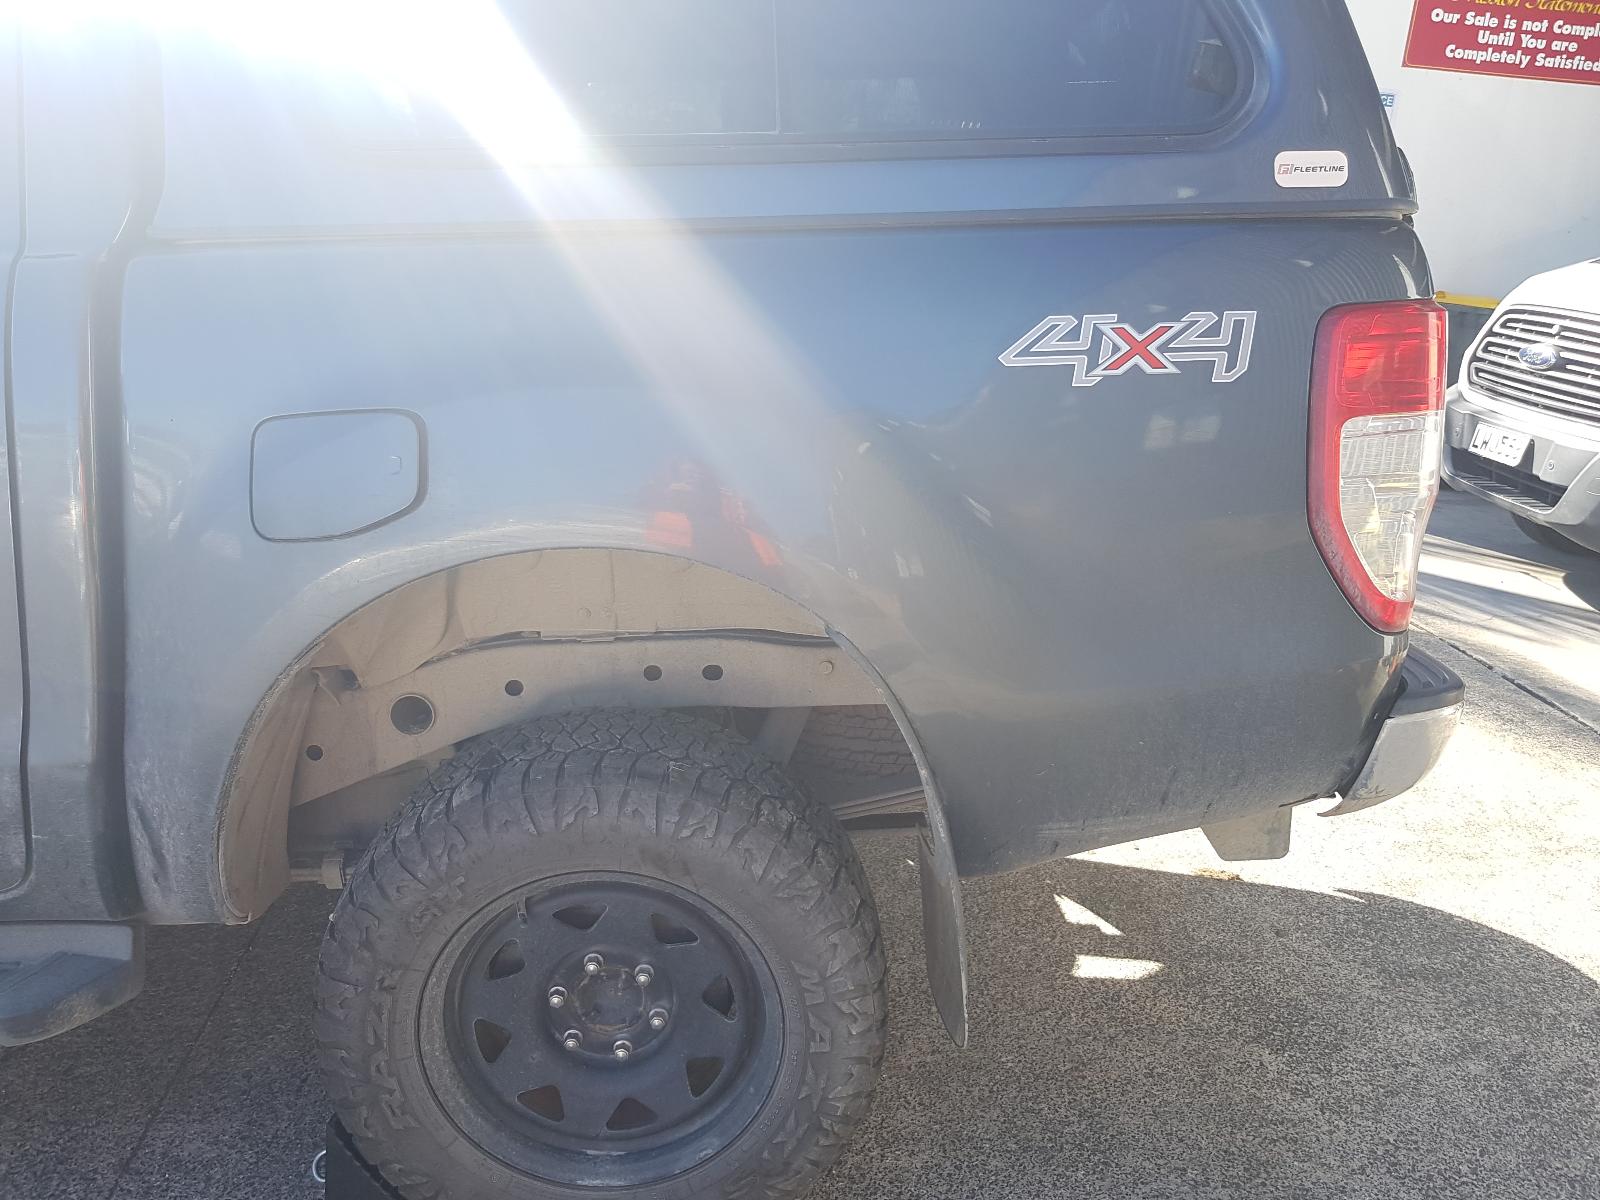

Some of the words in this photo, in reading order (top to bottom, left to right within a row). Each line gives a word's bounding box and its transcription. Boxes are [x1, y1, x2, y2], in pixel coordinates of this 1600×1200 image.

[1431, 8, 1461, 24] Our
[1464, 12, 1499, 28] Sale
[1503, 15, 1518, 30] is
[1522, 20, 1549, 33] not
[1552, 20, 1600, 40] Compl
[1477, 30, 1515, 47] Until
[1520, 34, 1547, 49] You
[1551, 40, 1578, 53] are
[1445, 44, 1531, 68] Completely
[1293, 165, 1345, 173] FLEETLINE
